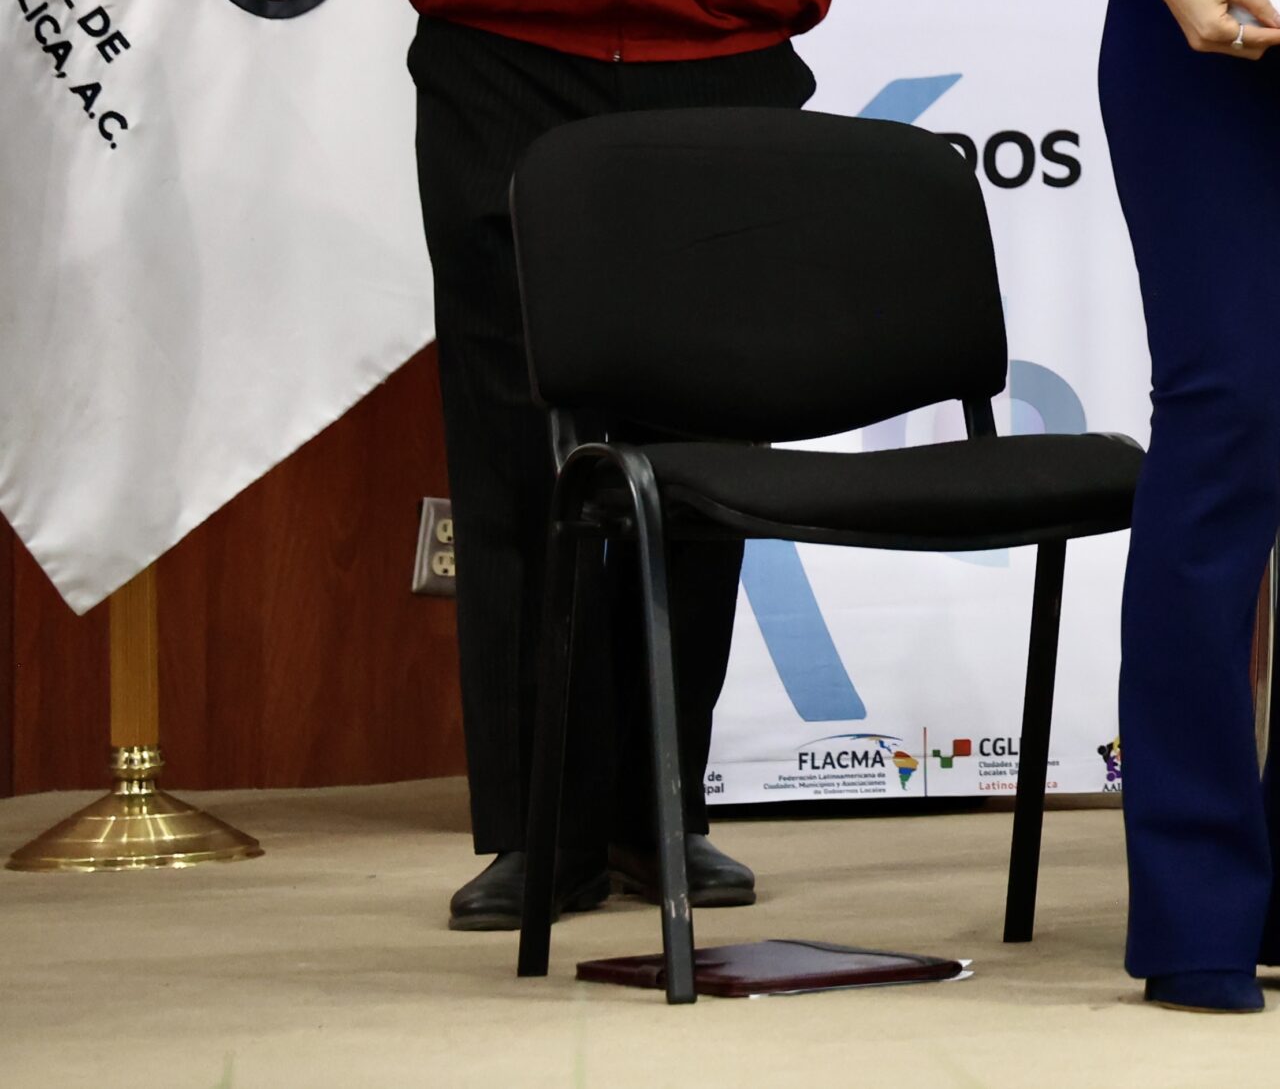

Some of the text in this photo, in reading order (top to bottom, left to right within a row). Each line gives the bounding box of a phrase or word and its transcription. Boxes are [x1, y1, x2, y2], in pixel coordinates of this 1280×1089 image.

[77, 5, 131, 63] DE
[69, 82, 128, 150] A.C.
[979, 737, 1021, 757] CGL
[798, 750, 886, 770] FLACMA
[707, 771, 722, 782] de
[778, 773, 817, 781] Federación
[818, 772, 875, 780] Latinoamericana
